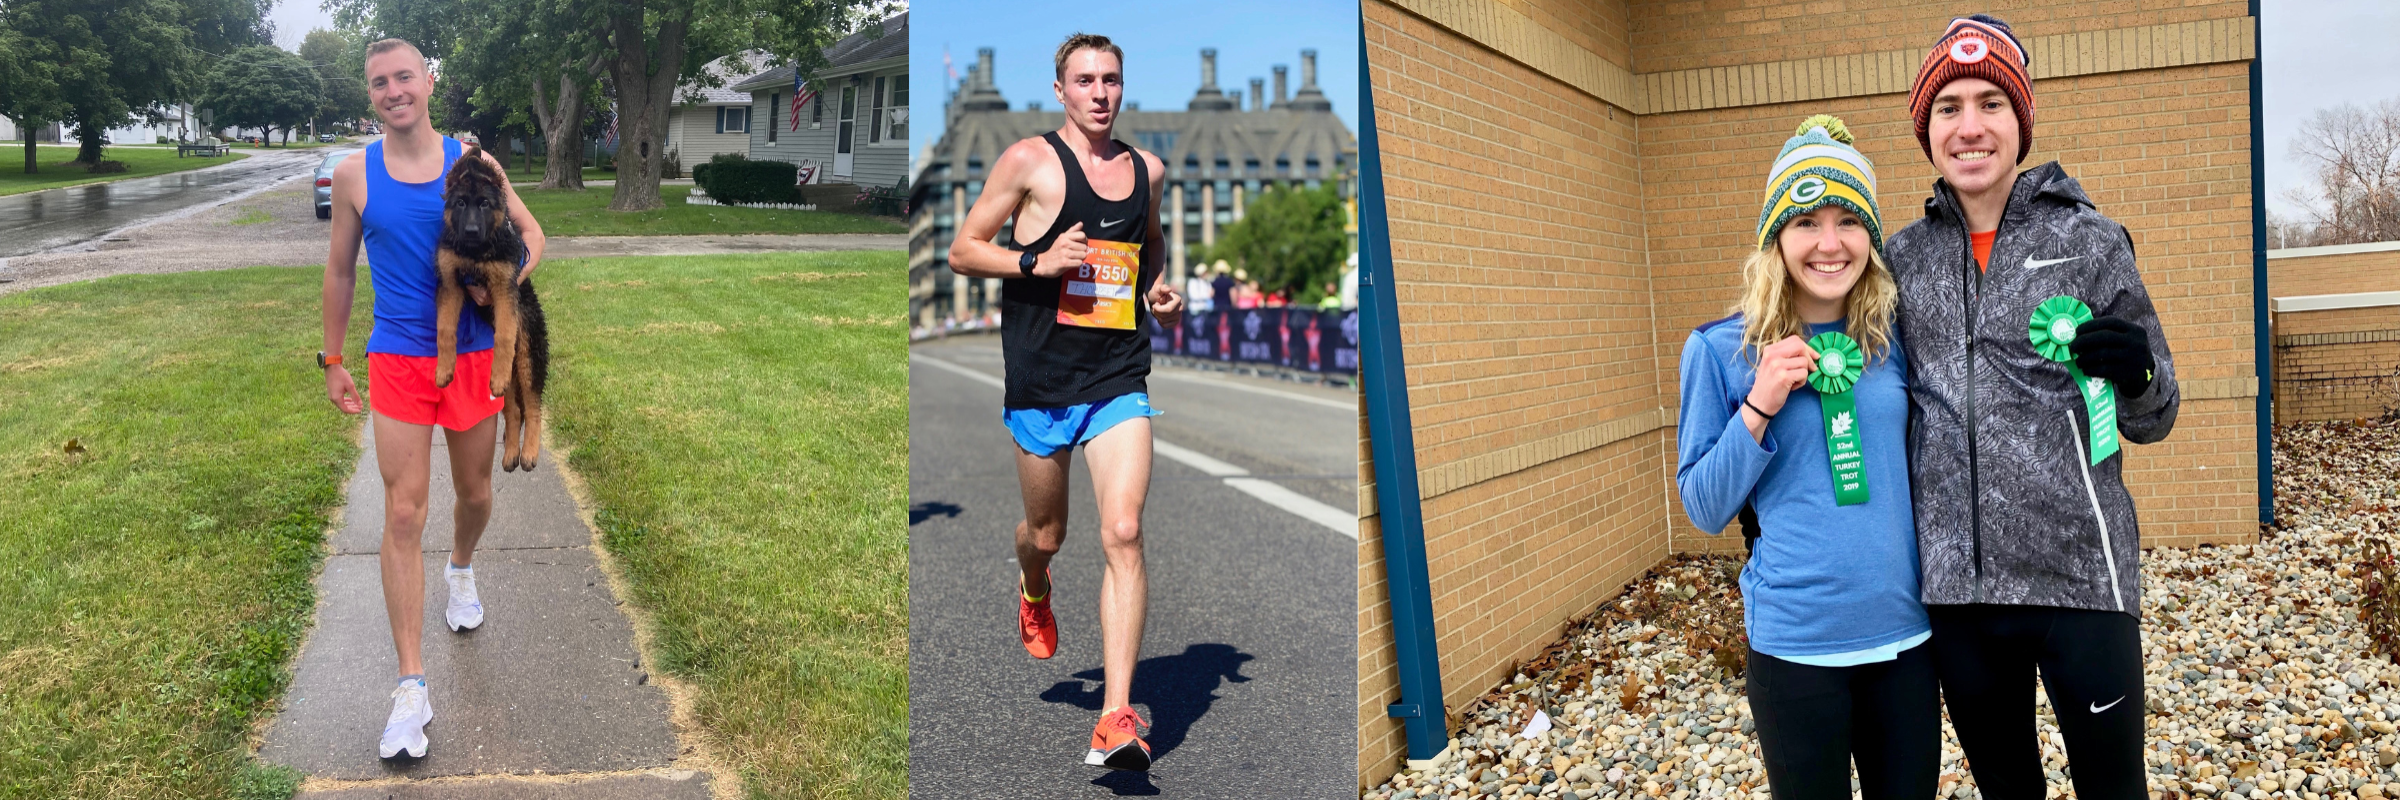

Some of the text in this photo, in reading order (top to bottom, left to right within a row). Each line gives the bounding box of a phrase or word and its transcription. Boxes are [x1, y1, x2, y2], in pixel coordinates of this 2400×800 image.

[1086, 247, 1098, 255] ORT
[1101, 249, 1126, 257] BRITISH
[1079, 263, 1129, 282] B7550
[2093, 413, 2113, 431] TURKEY
[2096, 425, 2110, 438] TROT
[1837, 441, 1853, 450] 52nd
[1833, 451, 1860, 461] ANNUAL
[1835, 461, 1860, 471] TURKEY
[1841, 472, 1858, 481] TROT
[1843, 482, 1859, 491] 2019
